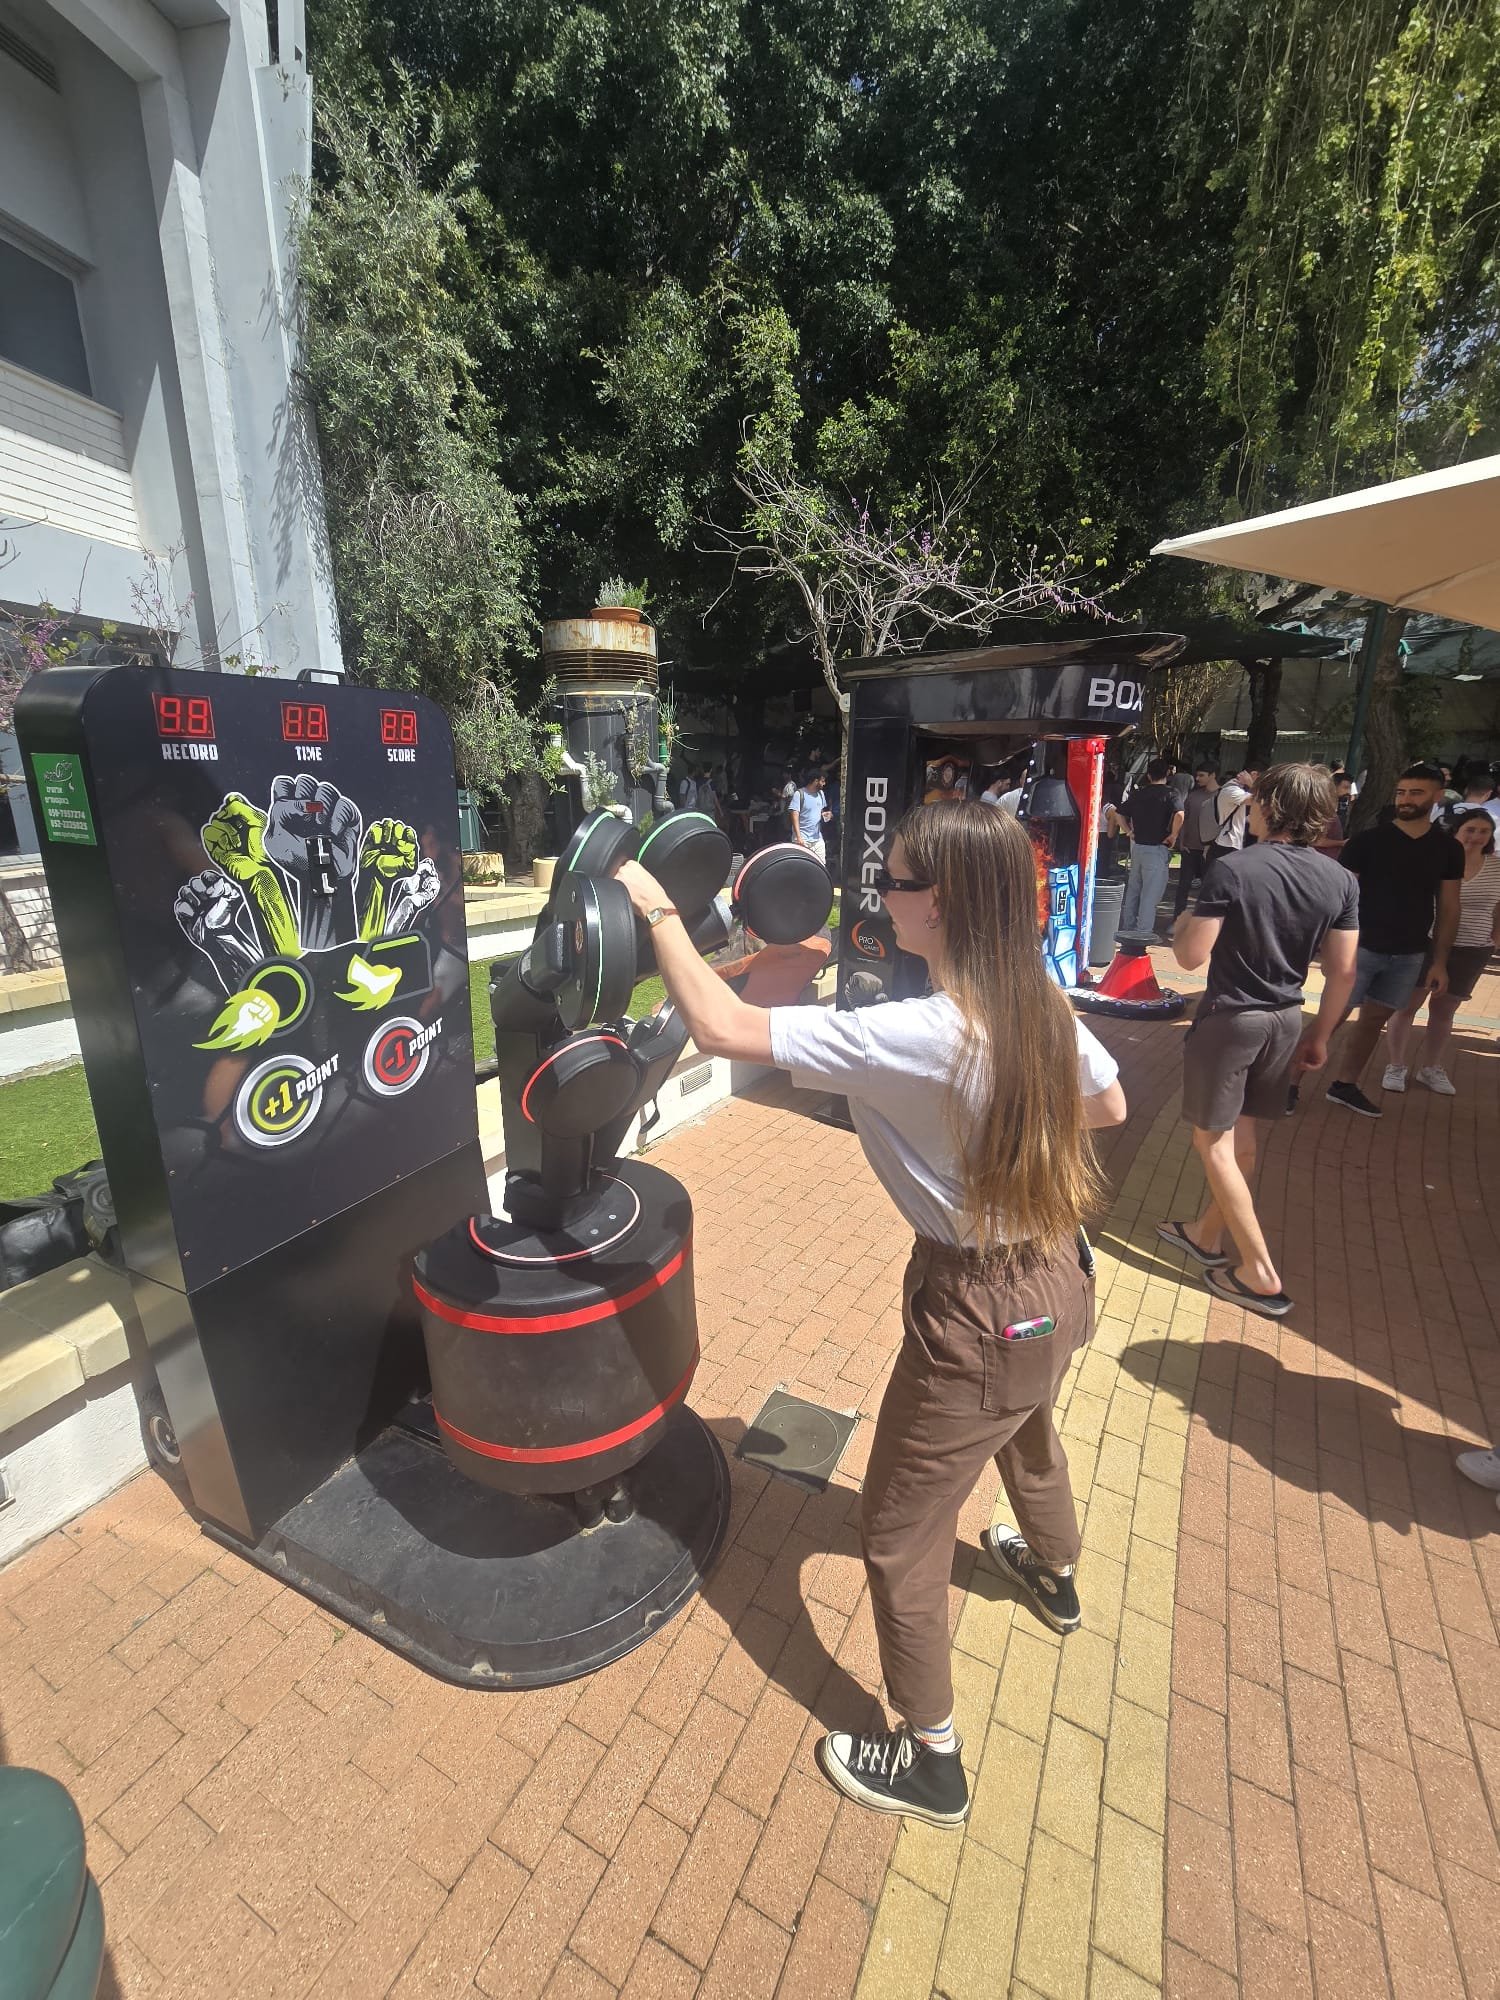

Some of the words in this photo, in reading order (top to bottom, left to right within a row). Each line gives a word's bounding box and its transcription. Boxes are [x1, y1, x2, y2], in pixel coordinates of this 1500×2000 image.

[161, 743, 219, 761] RECORD
[295, 746, 323, 761] TIME
[387, 749, 416, 762] SCORE
[859, 777, 888, 913] BOXER
[858, 935, 874, 945] PRO
[385, 1040, 406, 1069] -1
[409, 1017, 443, 1057] POINT
[264, 1081, 293, 1118] +1
[295, 1053, 339, 1100] POINT
